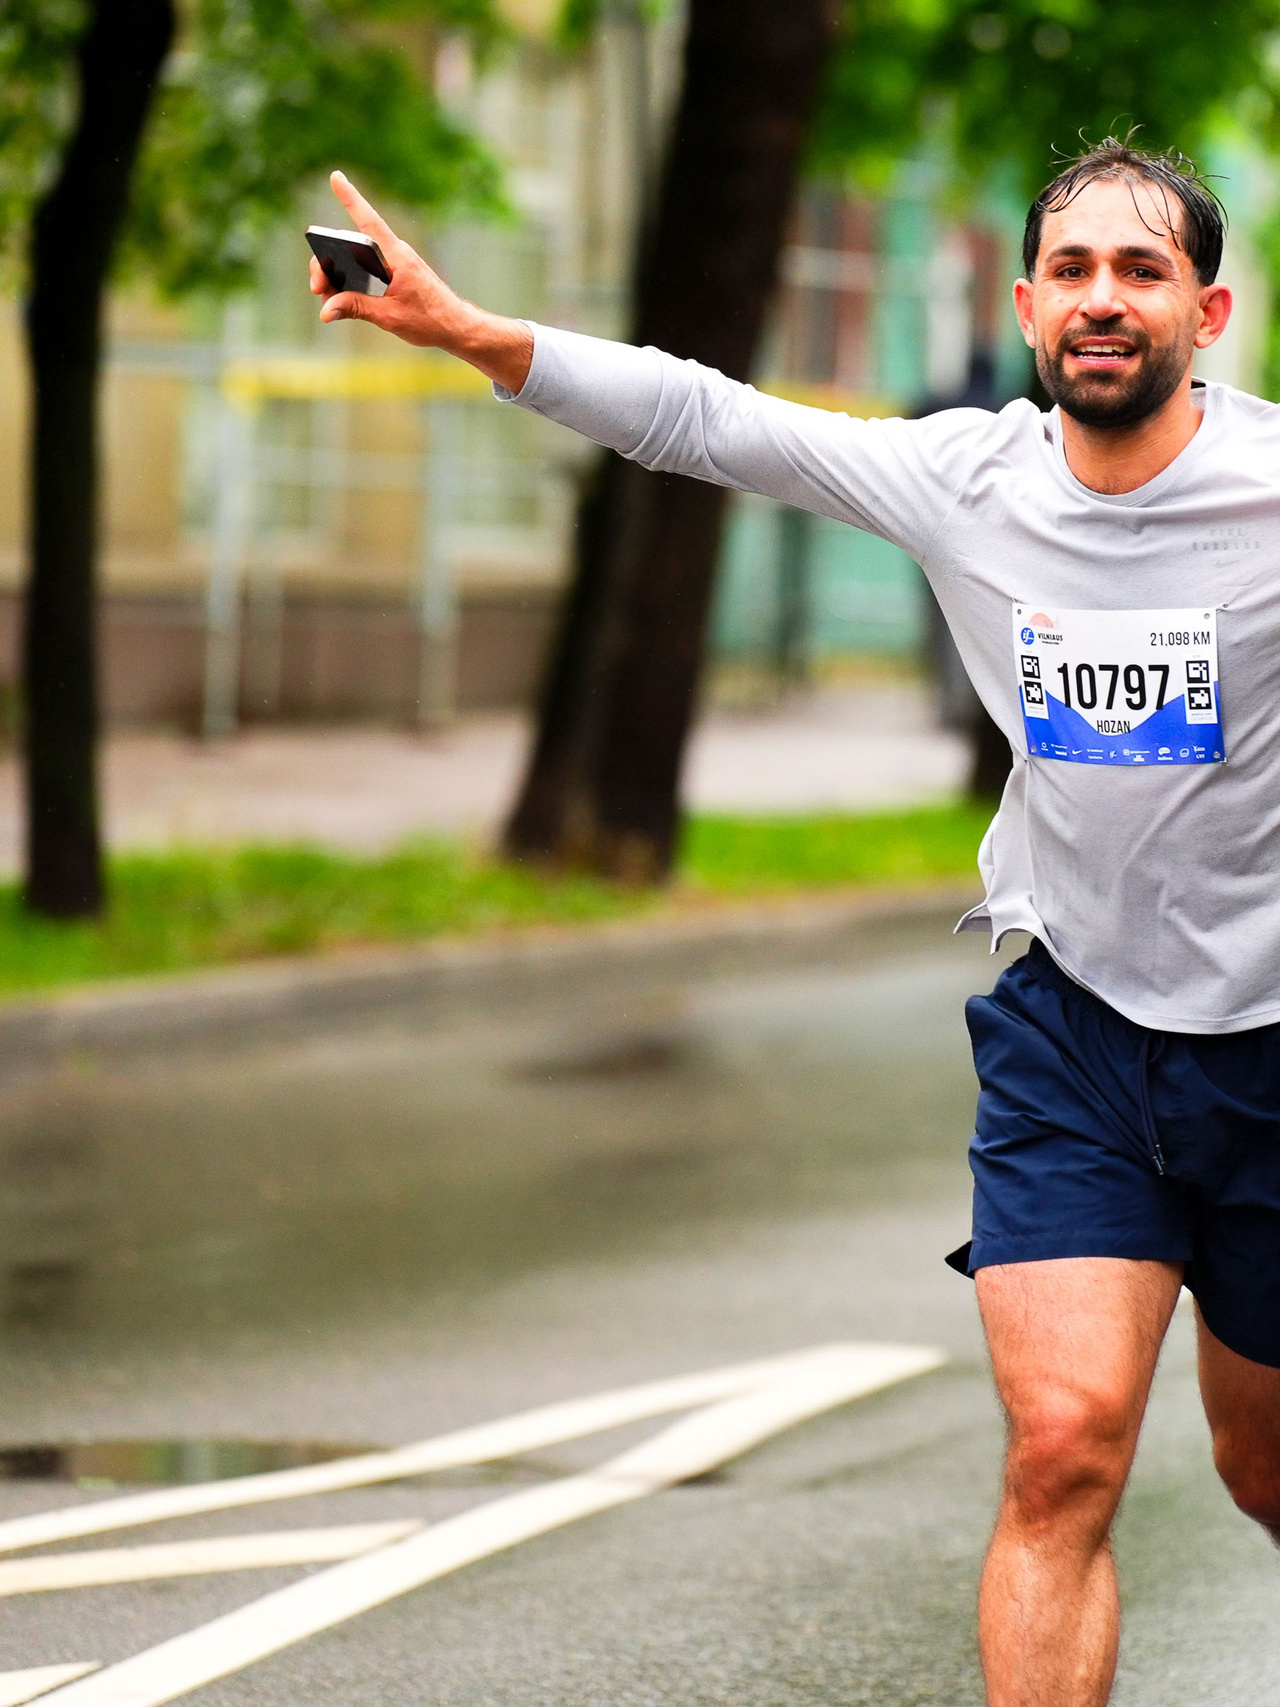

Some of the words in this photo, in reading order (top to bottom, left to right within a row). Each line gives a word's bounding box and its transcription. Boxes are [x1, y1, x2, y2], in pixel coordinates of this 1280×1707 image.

[1037, 632, 1063, 641] VILNIAUS
[1193, 631, 1211, 645] KM
[1057, 662, 1170, 711] 10797
[1096, 720, 1131, 734] HOZAN
